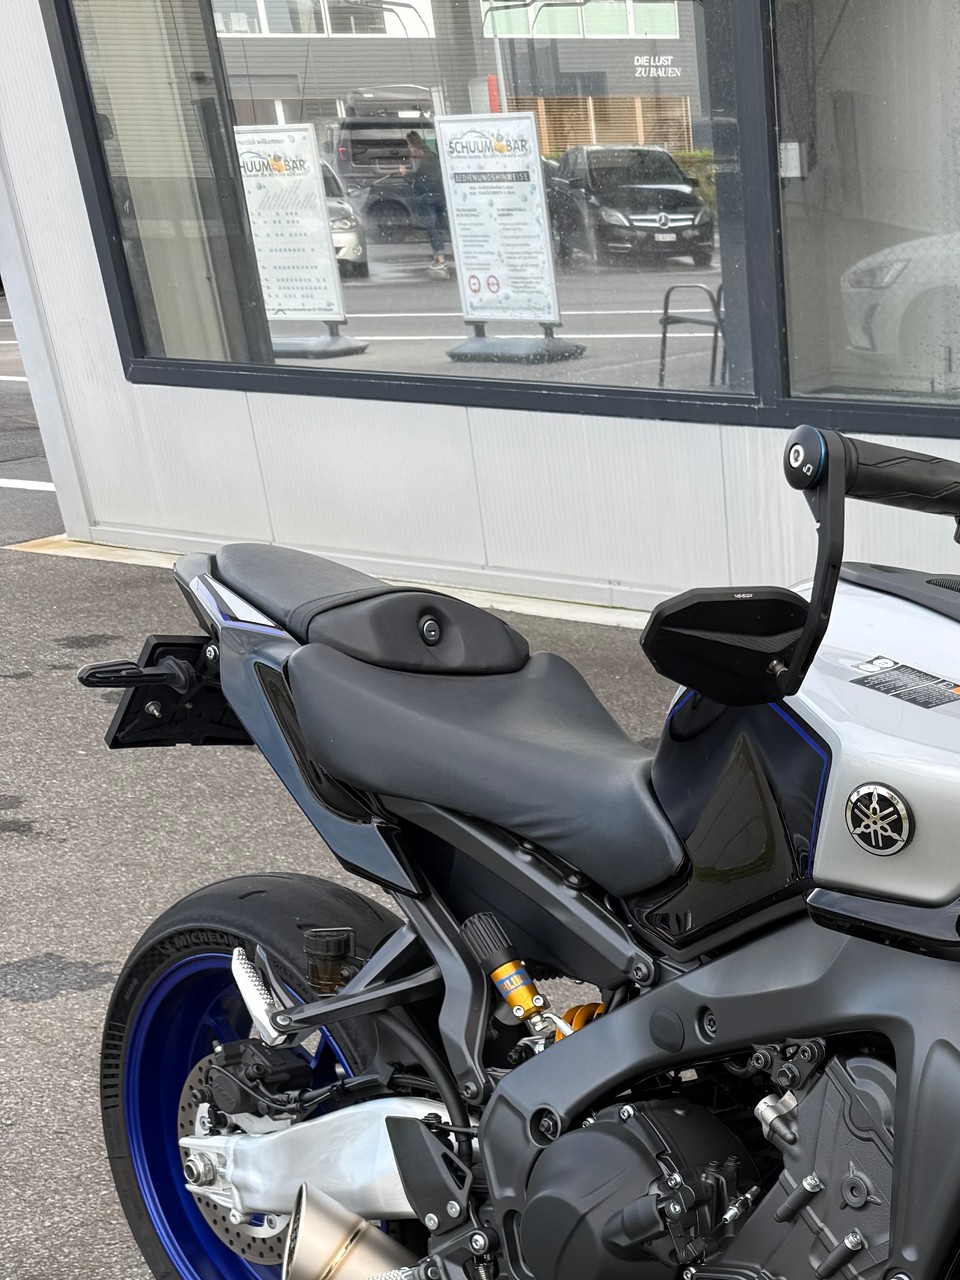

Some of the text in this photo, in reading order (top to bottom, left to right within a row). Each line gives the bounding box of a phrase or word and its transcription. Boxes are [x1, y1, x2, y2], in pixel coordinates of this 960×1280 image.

[634, 56, 673, 66] DIE LUST
[635, 67, 681, 77] ZU BAUEN
[449, 140, 494, 154] SCHUUM
[174, 929, 239, 948] MICHELIN
